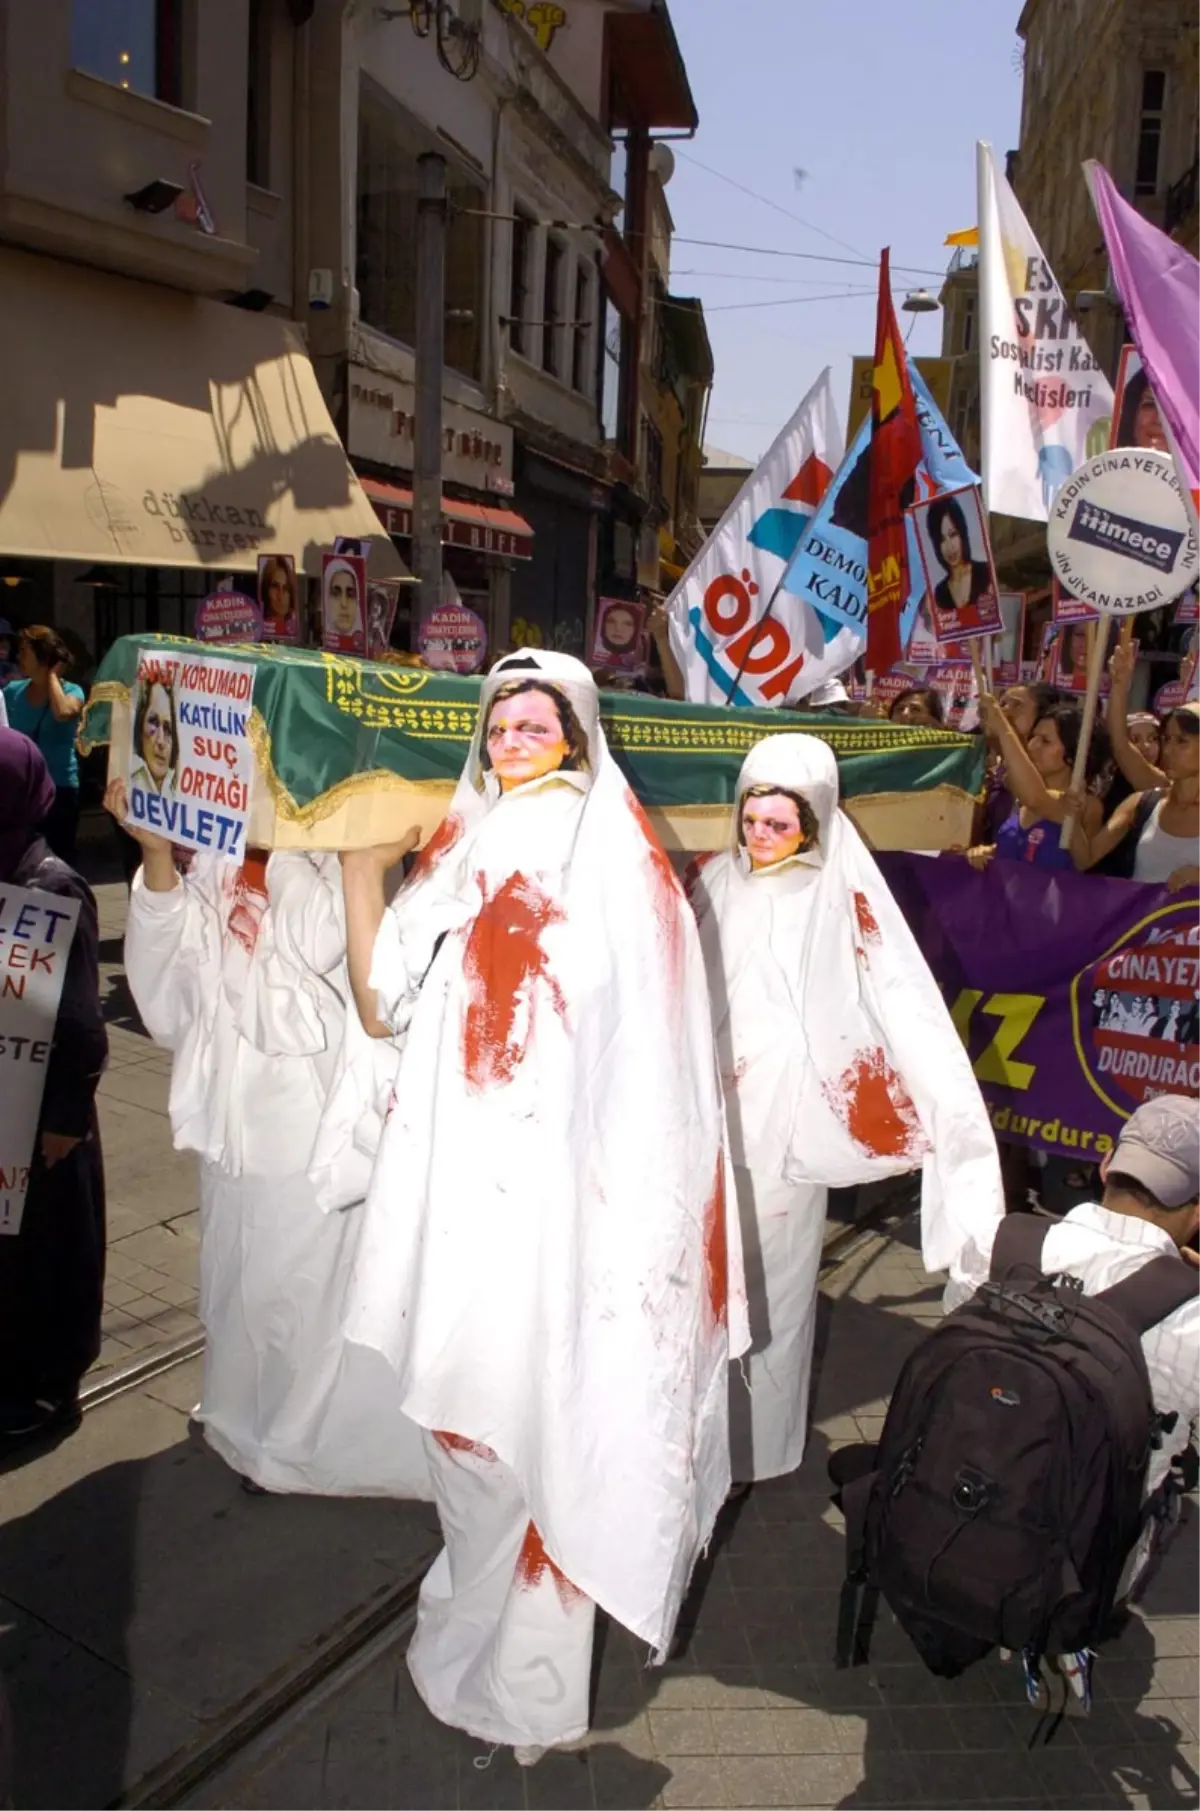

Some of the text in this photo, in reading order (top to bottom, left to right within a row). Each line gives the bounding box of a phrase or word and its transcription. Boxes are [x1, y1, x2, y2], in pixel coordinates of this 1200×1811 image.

[142, 489, 266, 529] dükkan
[162, 520, 261, 553] burger
[431, 612, 471, 624] KADIN
[180, 662, 253, 701] KORUMADI
[936, 667, 971, 681] KADI
[179, 701, 247, 737] KATİLİN
[193, 735, 238, 769] SUÇ
[180, 766, 248, 811] ORTAĞI
[131, 786, 243, 856] DEVLET!
